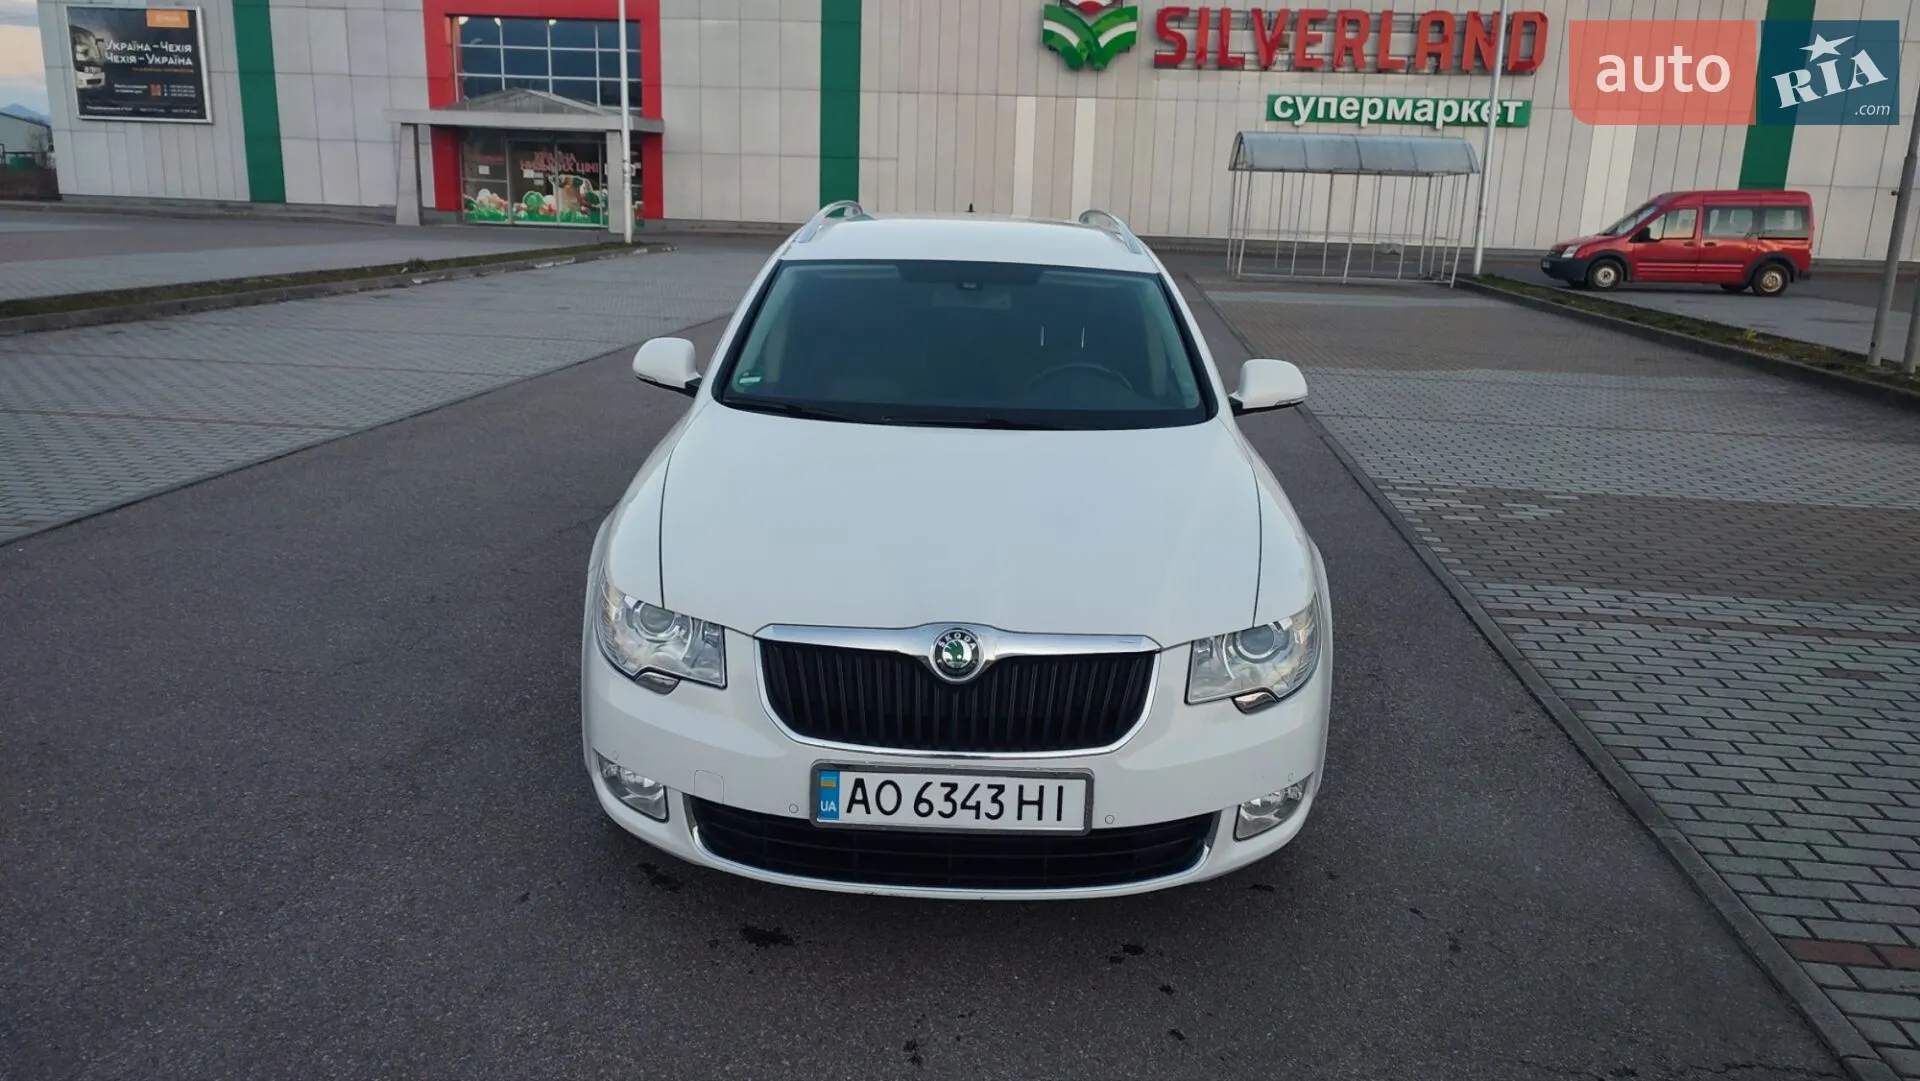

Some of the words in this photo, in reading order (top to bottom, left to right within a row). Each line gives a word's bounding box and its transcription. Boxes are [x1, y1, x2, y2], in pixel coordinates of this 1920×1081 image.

[1154, 7, 1548, 72] SILVERLAND
[1273, 95, 1523, 130] супермаркет
[820, 799, 837, 812] UA
[846, 777, 902, 816] AO
[913, 781, 1006, 820] 6343
